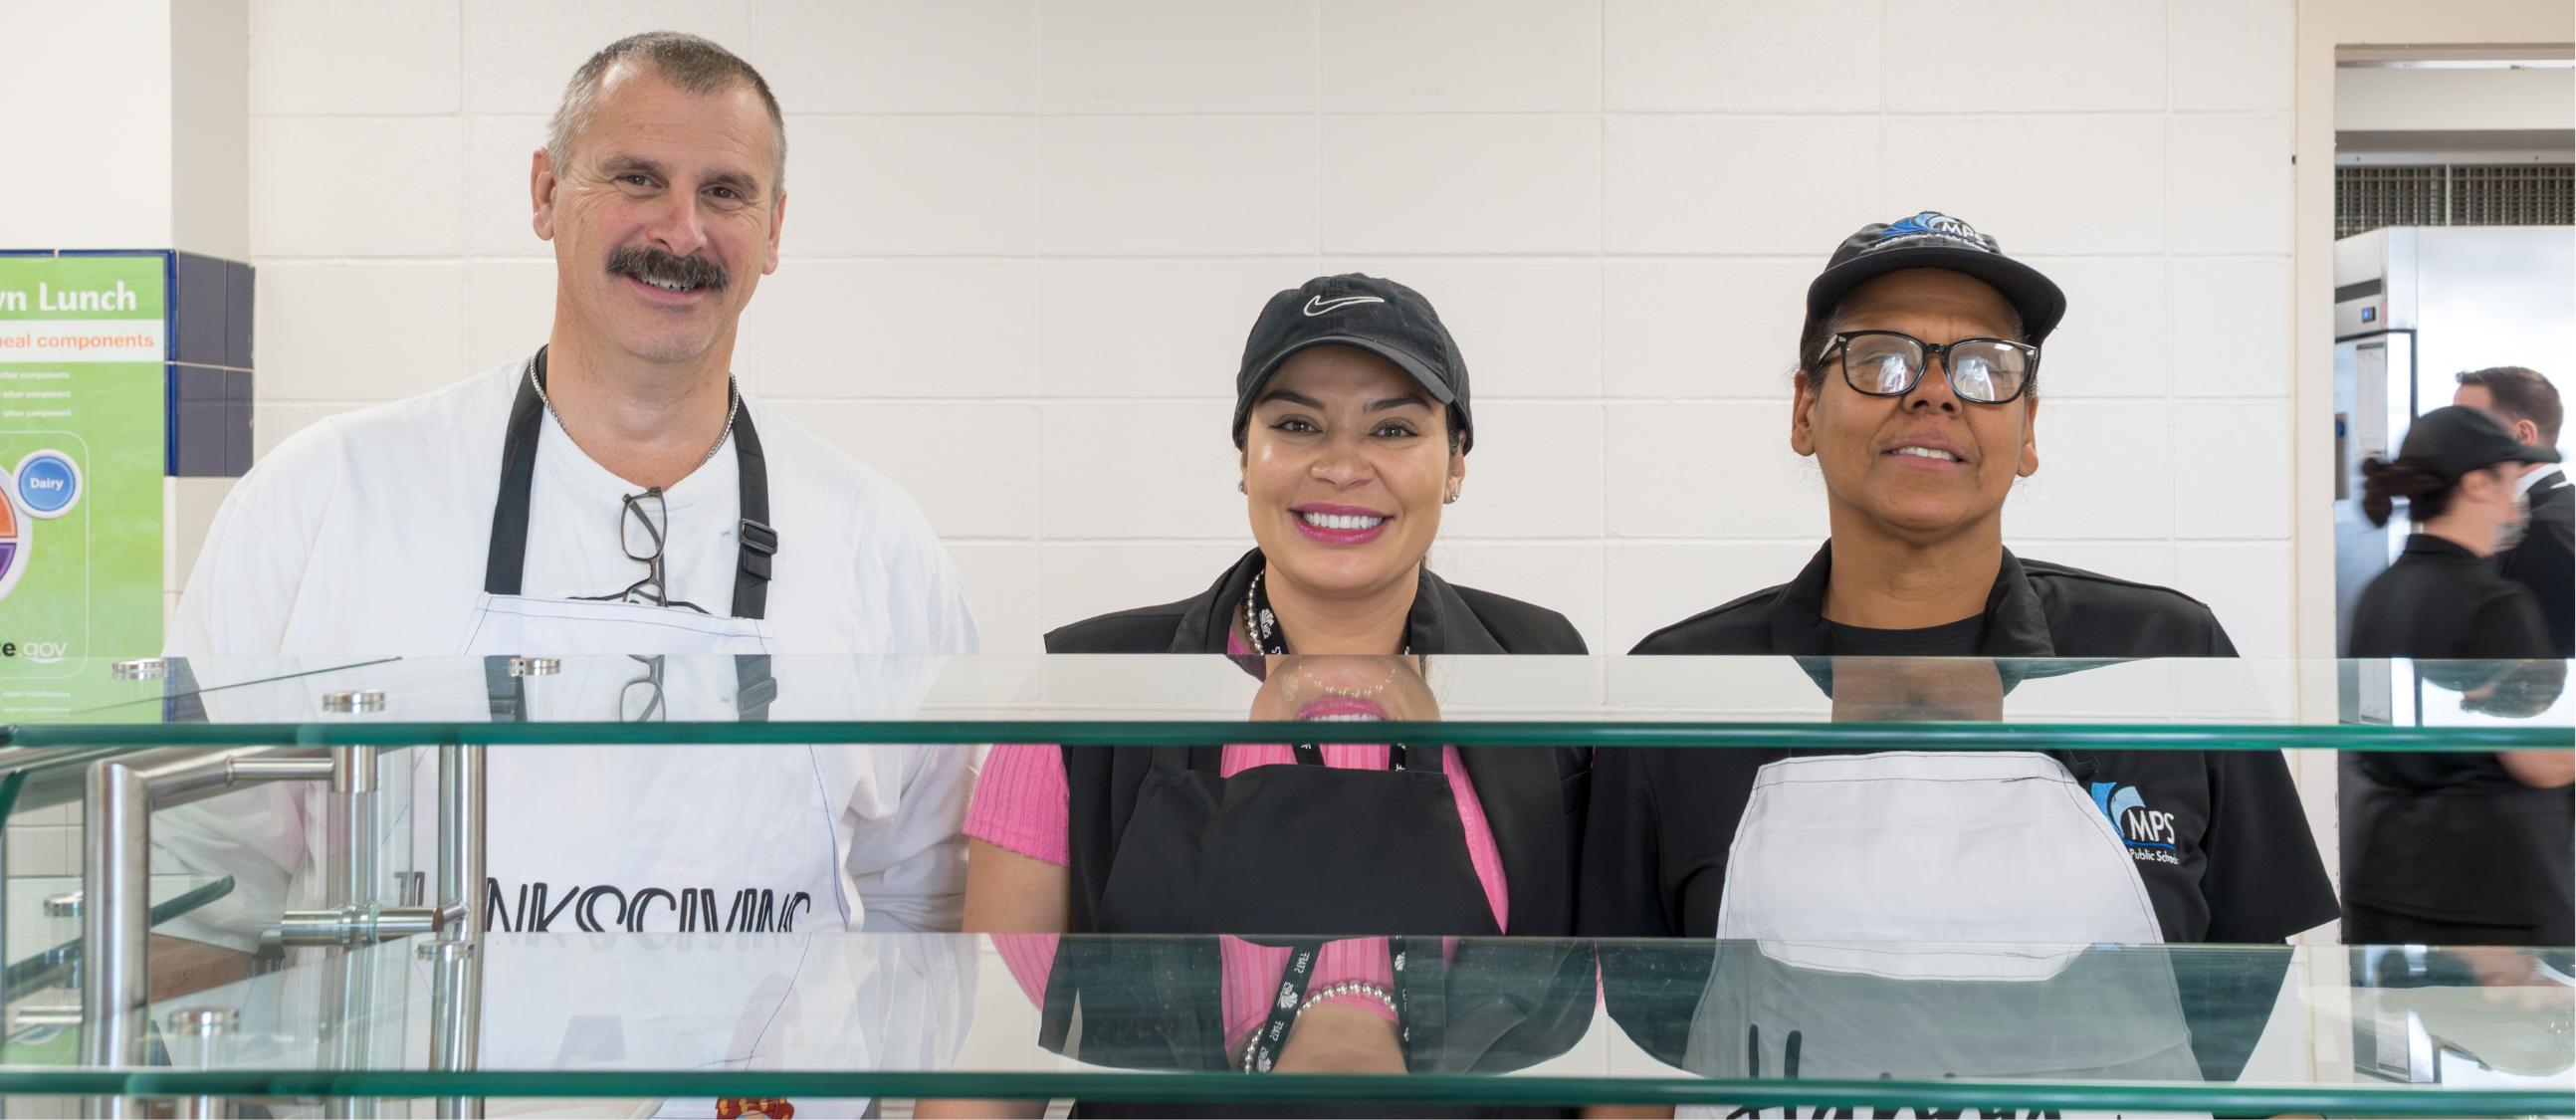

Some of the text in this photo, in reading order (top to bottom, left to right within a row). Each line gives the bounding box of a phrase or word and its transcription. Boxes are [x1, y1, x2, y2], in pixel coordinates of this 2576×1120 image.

[1942, 221, 1989, 247] MPS
[39, 280, 137, 312] Lunch
[37, 333, 154, 350] components
[30, 477, 64, 492] Dairy
[2127, 808, 2176, 844] MPS
[2129, 847, 2155, 861] Public
